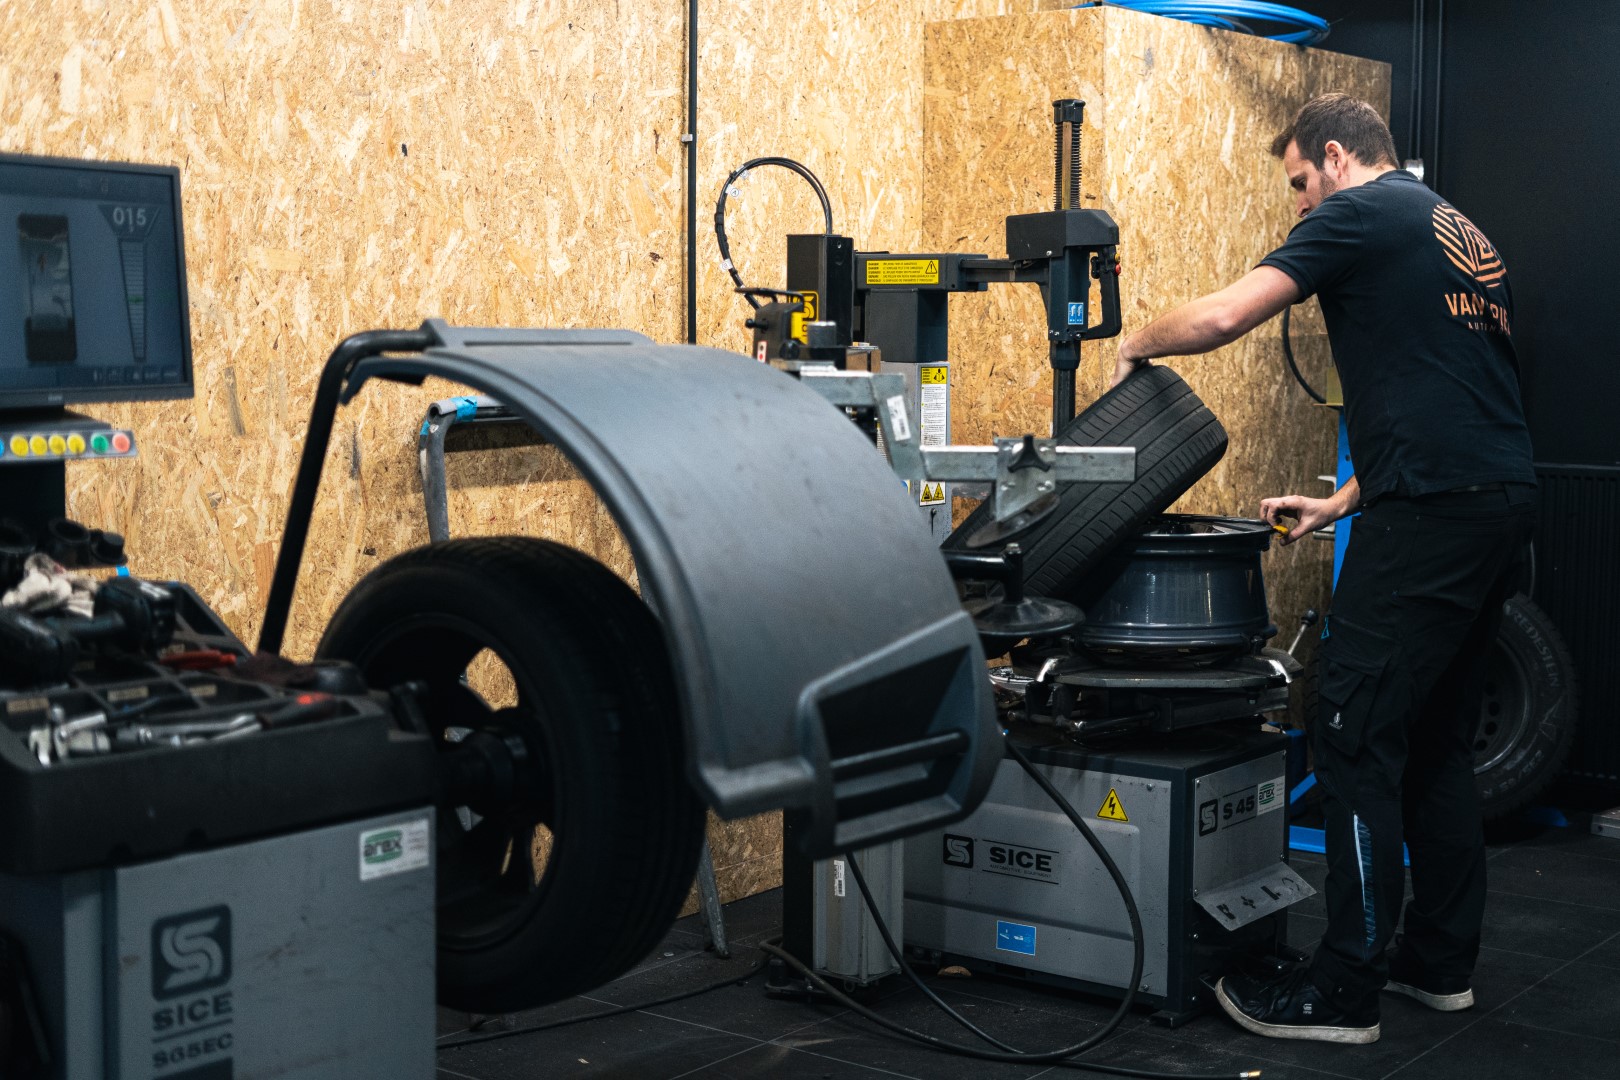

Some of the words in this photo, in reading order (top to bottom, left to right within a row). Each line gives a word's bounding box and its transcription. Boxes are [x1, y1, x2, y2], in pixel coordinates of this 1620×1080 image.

[113, 207, 147, 226] 015
[1444, 292, 1485, 316] VAN
[1223, 802, 1233, 820] S
[1236, 795, 1255, 814] 45
[990, 846, 1052, 873] SICE
[152, 991, 233, 1033] SICE
